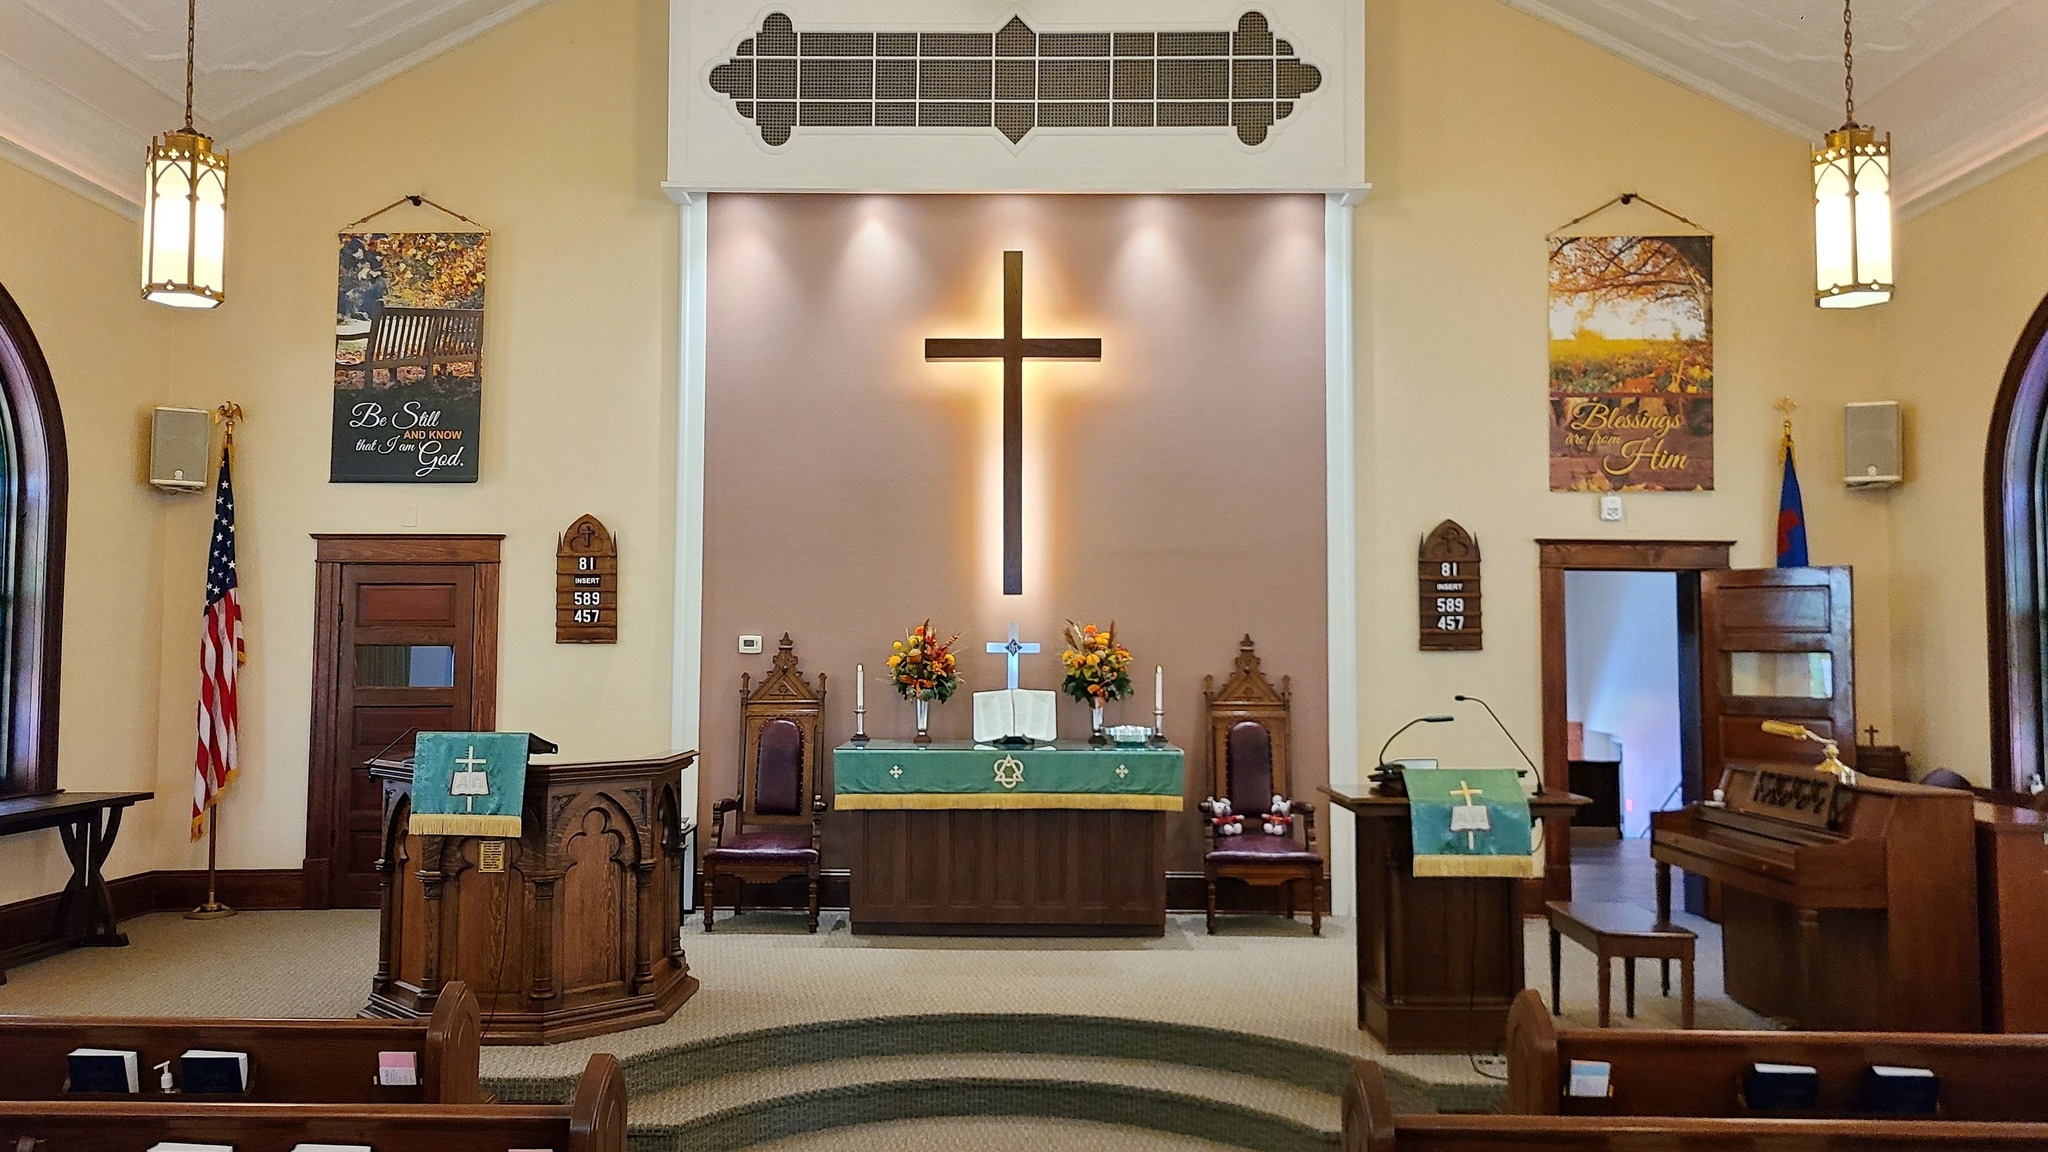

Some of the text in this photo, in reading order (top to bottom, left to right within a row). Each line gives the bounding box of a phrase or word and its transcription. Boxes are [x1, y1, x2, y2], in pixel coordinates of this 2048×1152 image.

[349, 401, 441, 430] Be Still
[1570, 402, 1682, 438] Blessings
[403, 430, 462, 440] AND KNOW
[1564, 430, 1622, 452] are from
[355, 435, 465, 477] that I am God.
[1603, 437, 1688, 475] Him
[579, 556, 594, 571] 81
[1441, 562, 1458, 577] 81
[1436, 582, 1463, 591] INSERT
[574, 592, 600, 606] 589
[1436, 597, 1465, 613] 589
[574, 609, 600, 623] 457
[1437, 615, 1465, 631] 457
